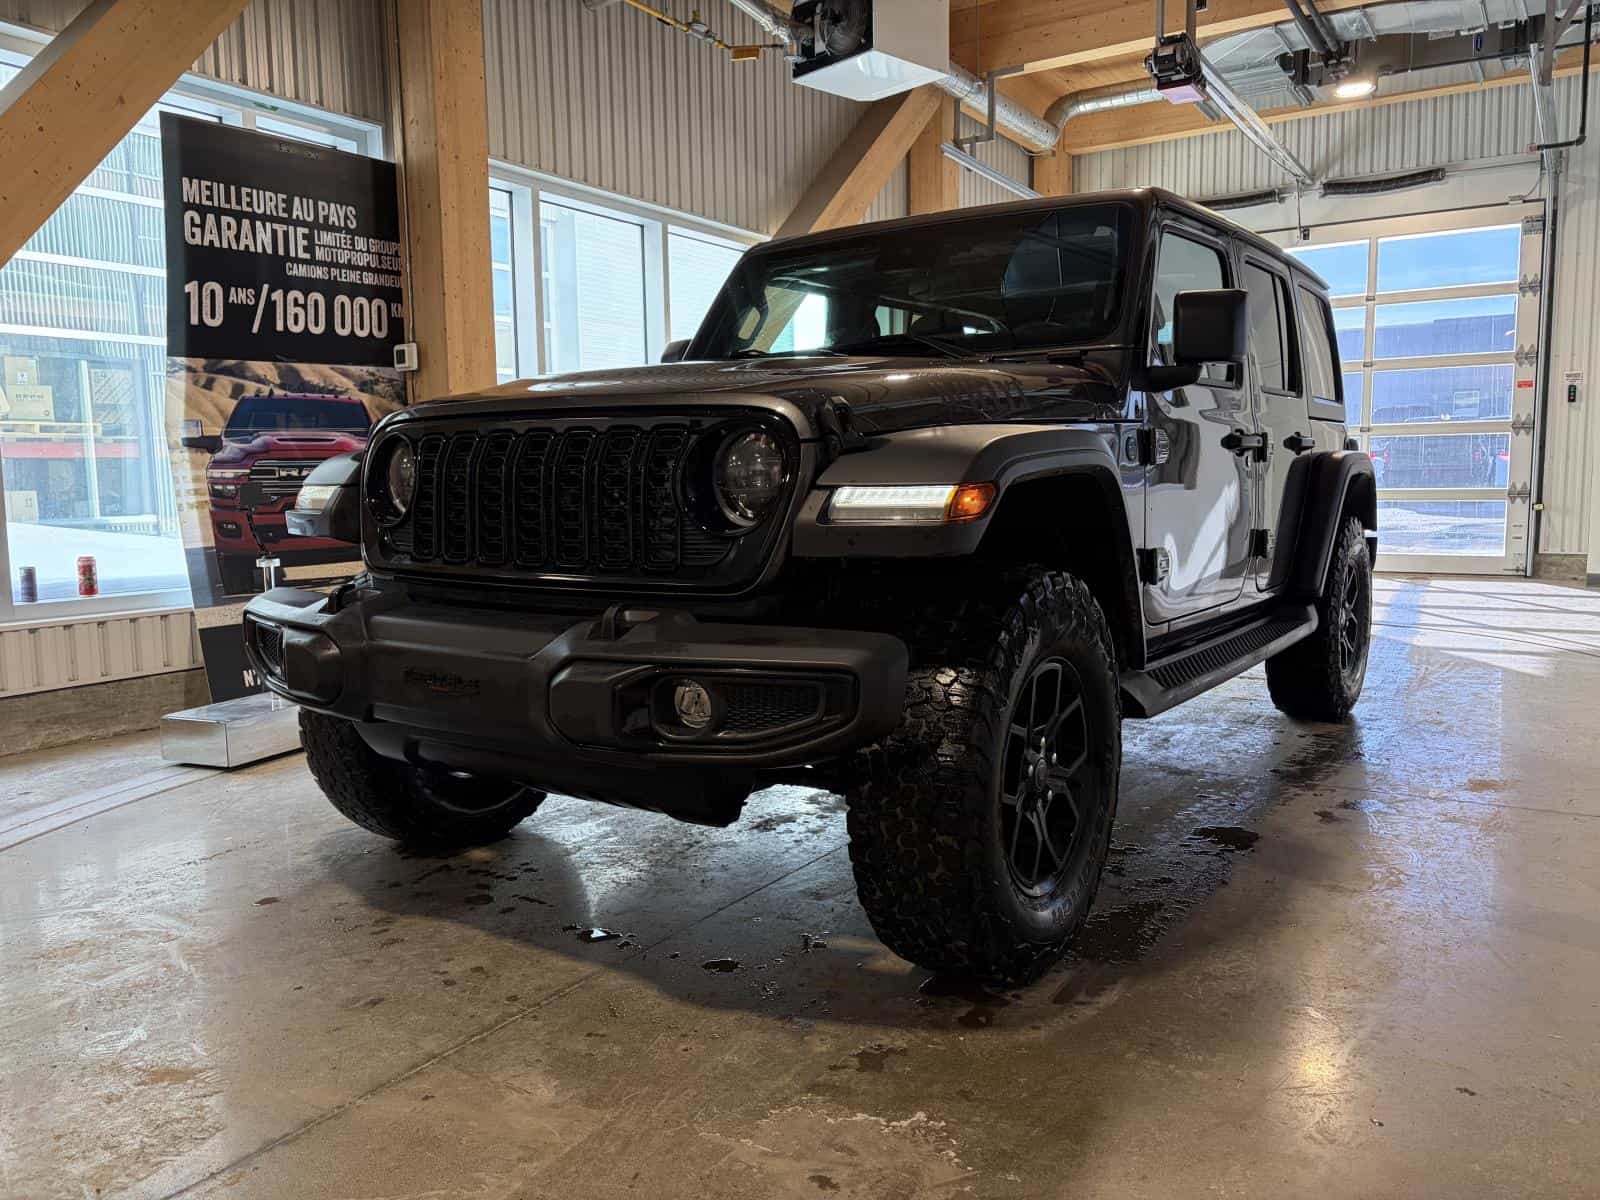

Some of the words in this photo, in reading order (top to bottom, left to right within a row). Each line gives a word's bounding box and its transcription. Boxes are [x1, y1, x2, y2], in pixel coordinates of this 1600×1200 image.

[182, 177, 288, 218] MEILLEURE
[292, 196, 314, 222] AU
[318, 200, 357, 229] PAYS
[184, 210, 311, 260] GARANTIE
[314, 229, 353, 250] LIMITÉE
[354, 236, 367, 252] DU
[286, 262, 329, 280] CAMIONS
[330, 268, 362, 284] PLEINE
[362, 272, 401, 288] GRANDEU
[315, 246, 401, 270] MOTOPROPULSEU
[184, 280, 224, 328] 10
[334, 294, 388, 339] 000
